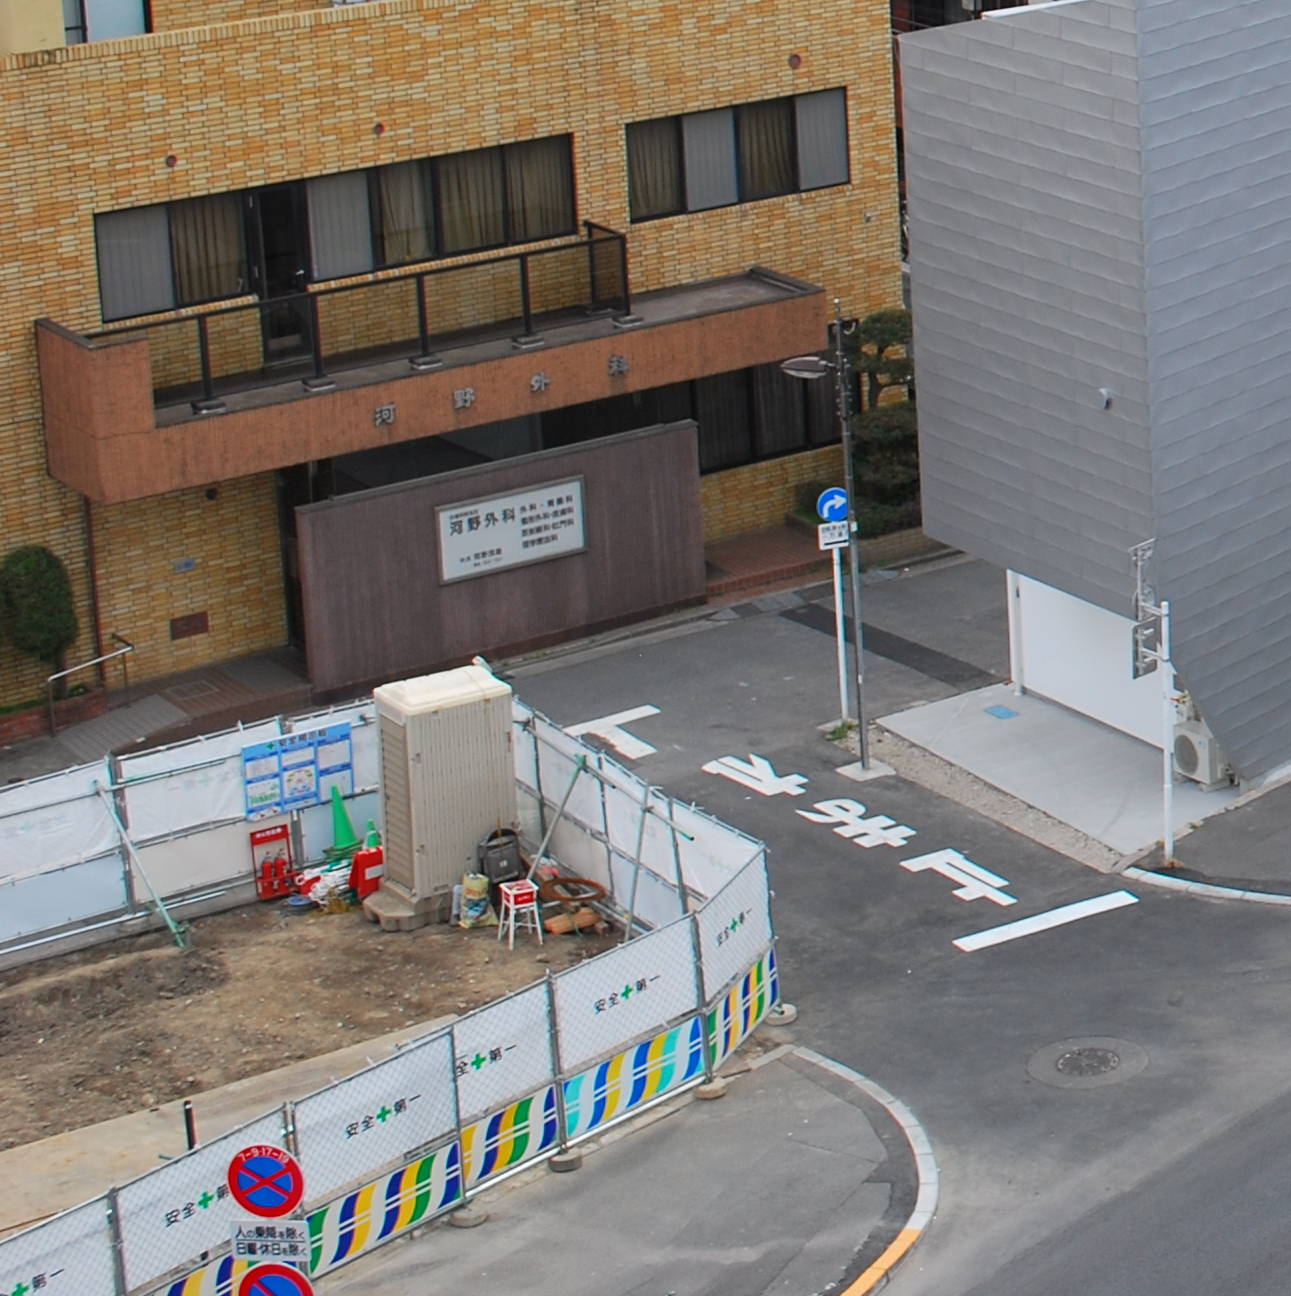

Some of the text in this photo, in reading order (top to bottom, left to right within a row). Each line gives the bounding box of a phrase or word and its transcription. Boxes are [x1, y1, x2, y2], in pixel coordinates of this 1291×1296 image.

[374, 354, 630, 427] 河野外科
[449, 507, 517, 537] 河野外科
[593, 975, 662, 1014] 安全 第一
[489, 1044, 518, 1063] 第一
[344, 1092, 423, 1140] 安全 第一
[164, 1201, 197, 1228] 安全
[31, 1267, 66, 1291] 第一
